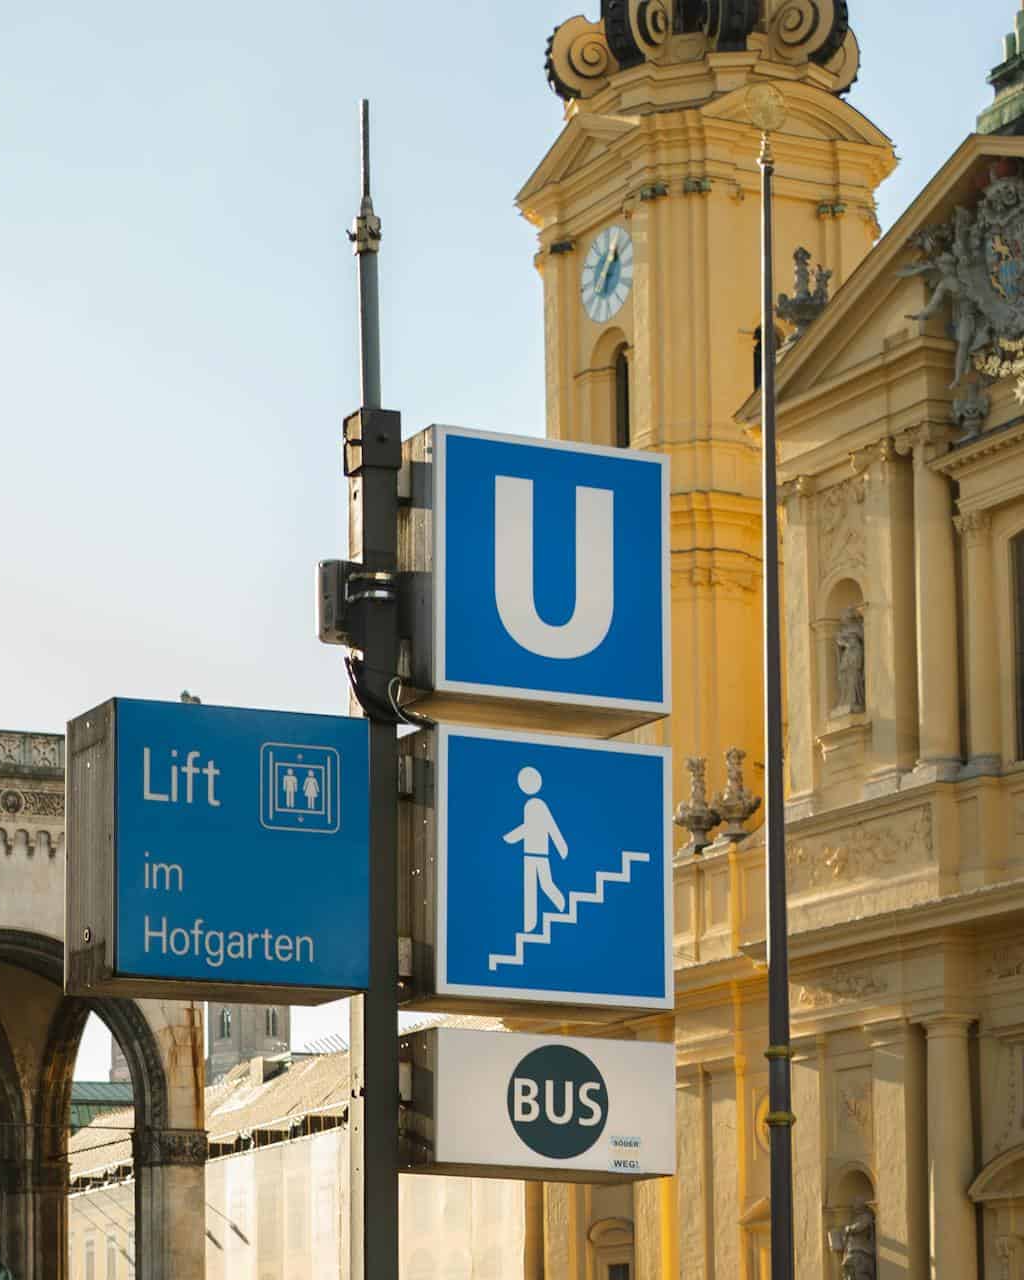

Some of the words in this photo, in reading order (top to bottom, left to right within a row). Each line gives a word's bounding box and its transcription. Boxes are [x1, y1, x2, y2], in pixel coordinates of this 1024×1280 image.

[494, 474, 615, 660] U
[143, 746, 222, 808] Lift
[144, 851, 183, 891] im
[143, 914, 314, 968] Hofgarten
[513, 1077, 603, 1127] BUS
[613, 1159, 640, 1169] WEG!
